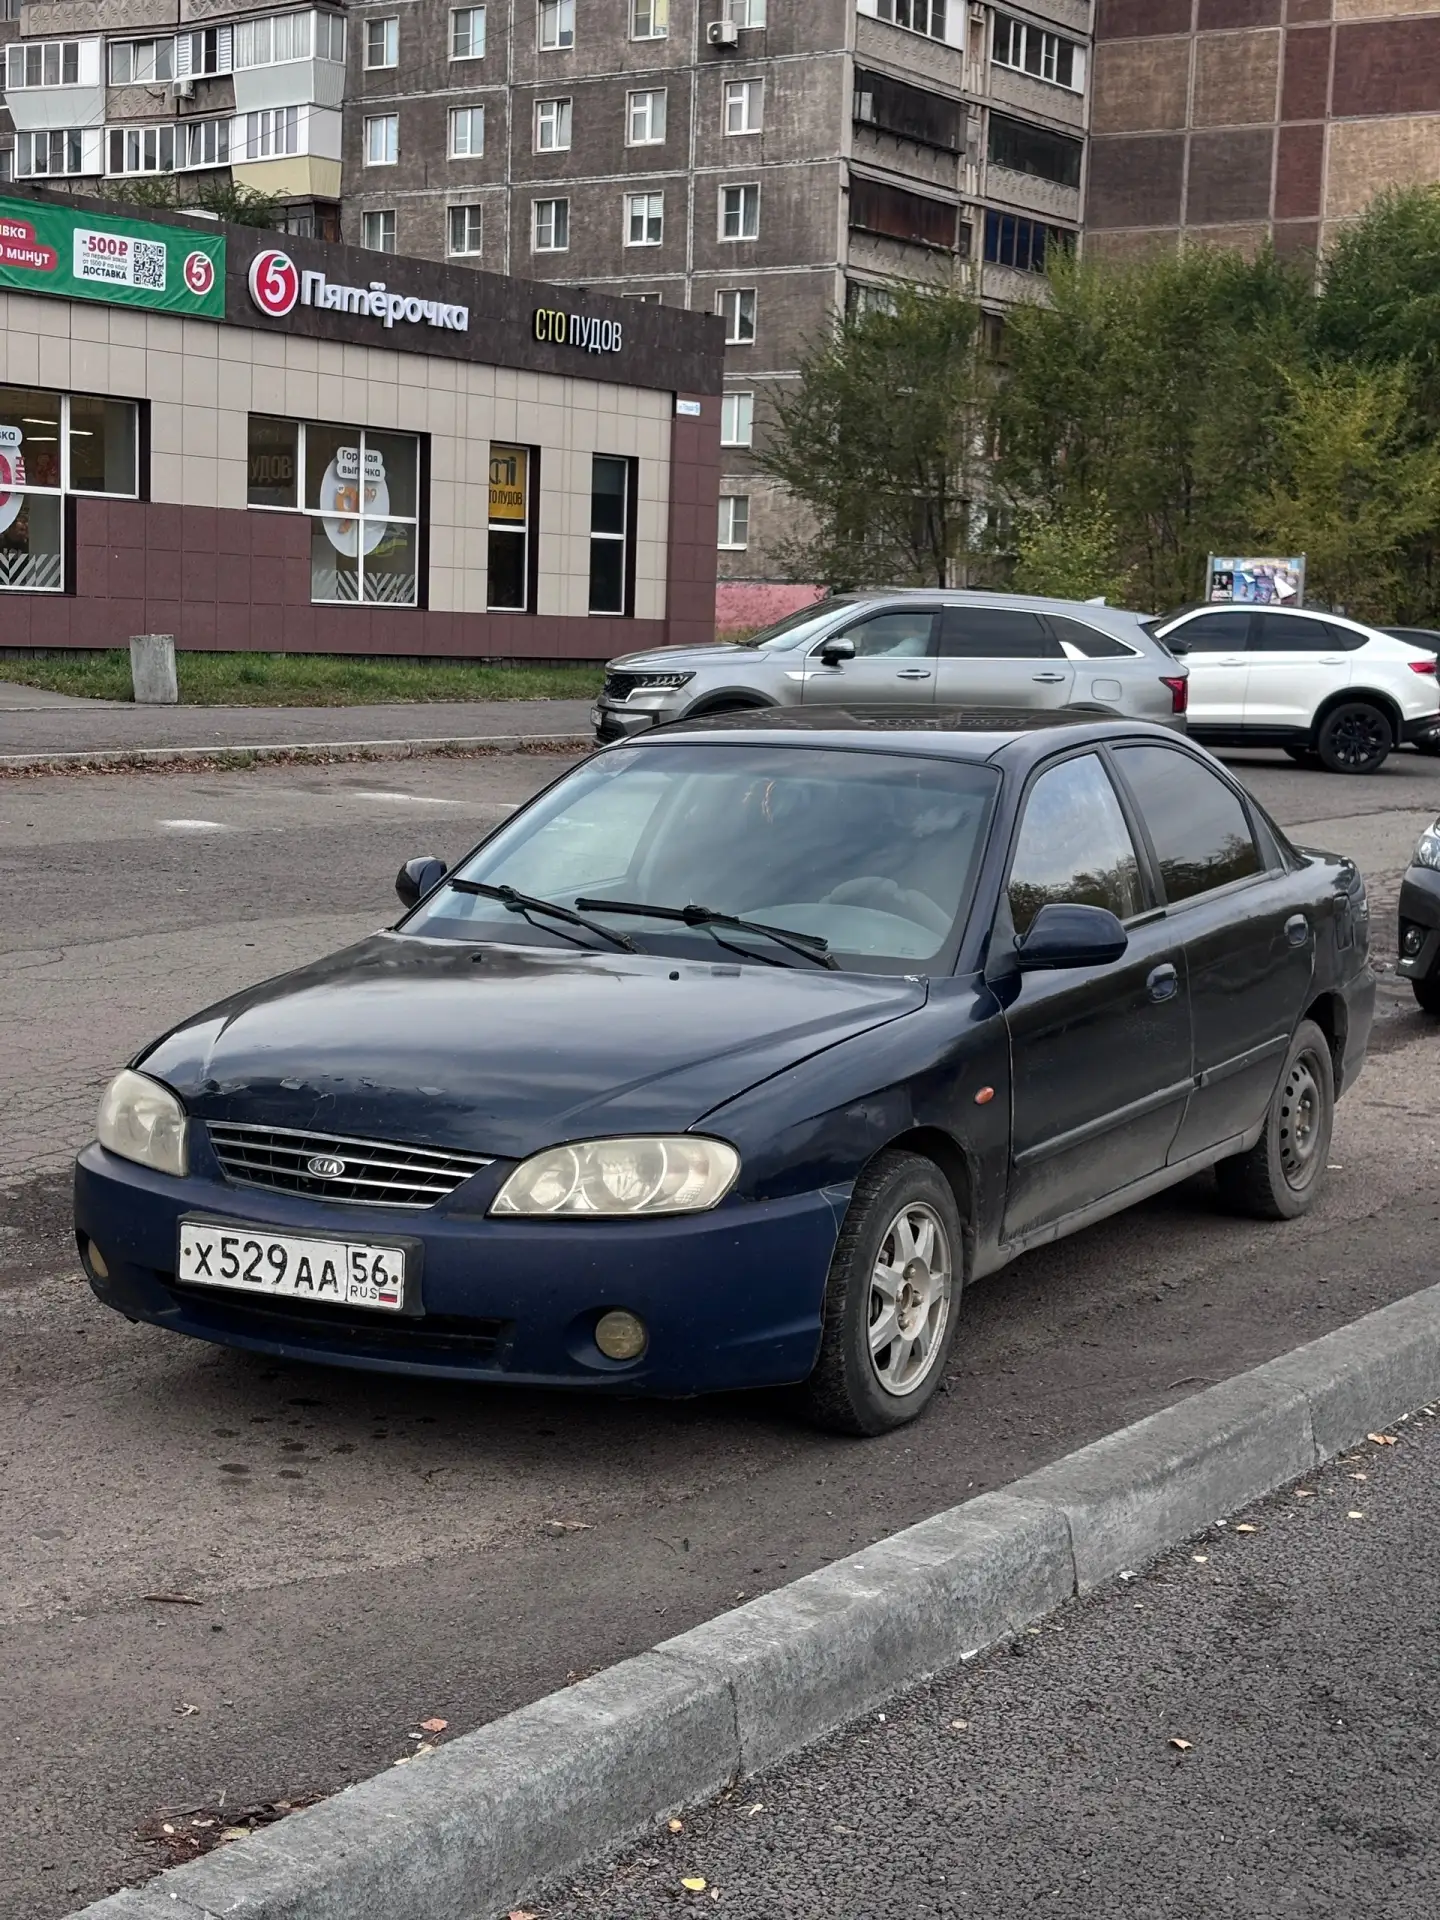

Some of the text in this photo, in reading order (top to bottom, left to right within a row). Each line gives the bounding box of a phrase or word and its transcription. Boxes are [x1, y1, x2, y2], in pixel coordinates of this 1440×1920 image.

[7, 247, 50, 267] минут
[83, 265, 127, 280] ДОСТАВКА
[301, 269, 469, 332] Пятёрочка
[535, 308, 623, 354] СТО ПУДОВ
[0, 430, 16, 441] ка
[342, 450, 378, 463] Горая
[342, 466, 381, 477] выпчка
[312, 1157, 339, 1175] KIA
[194, 1236, 389, 1294] Х529АА 56
[350, 1284, 378, 1299] RUS
